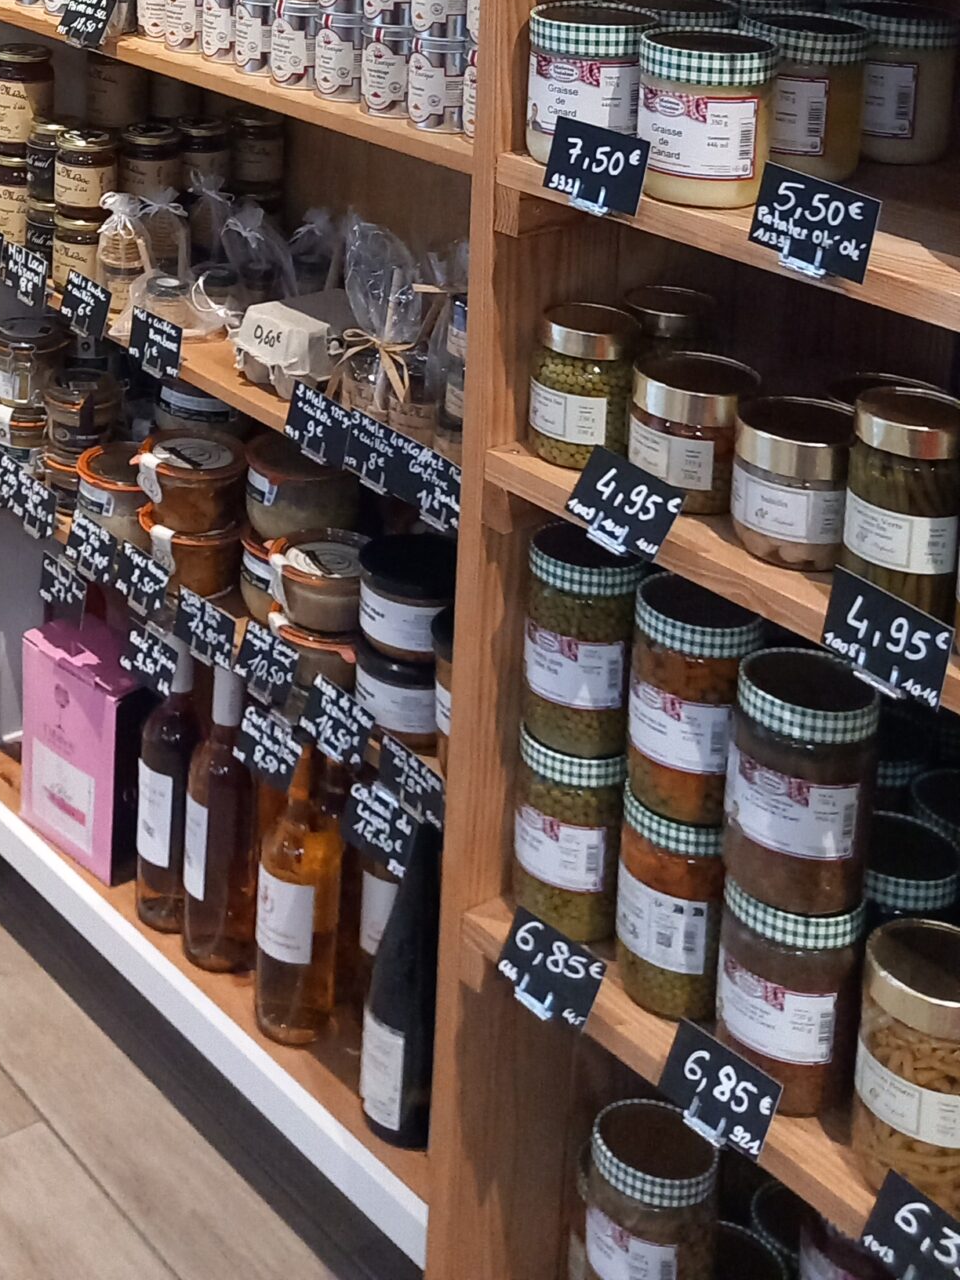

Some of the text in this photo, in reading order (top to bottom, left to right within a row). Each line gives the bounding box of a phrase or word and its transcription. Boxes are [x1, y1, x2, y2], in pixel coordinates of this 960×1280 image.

[547, 83, 580, 97] Graisse
[555, 96, 567, 106] de
[547, 105, 578, 119] Canard
[650, 122, 684, 138] Graisse
[658, 137, 670, 147] de
[566, 136, 641, 176] 7,50€
[650, 146, 681, 161] Canard
[771, 180, 866, 227] 5,50€
[595, 467, 682, 521] 4,95€
[846, 594, 951, 661] 4,95€
[514, 920, 603, 980] 6,85€
[682, 1049, 773, 1117] 6,85€
